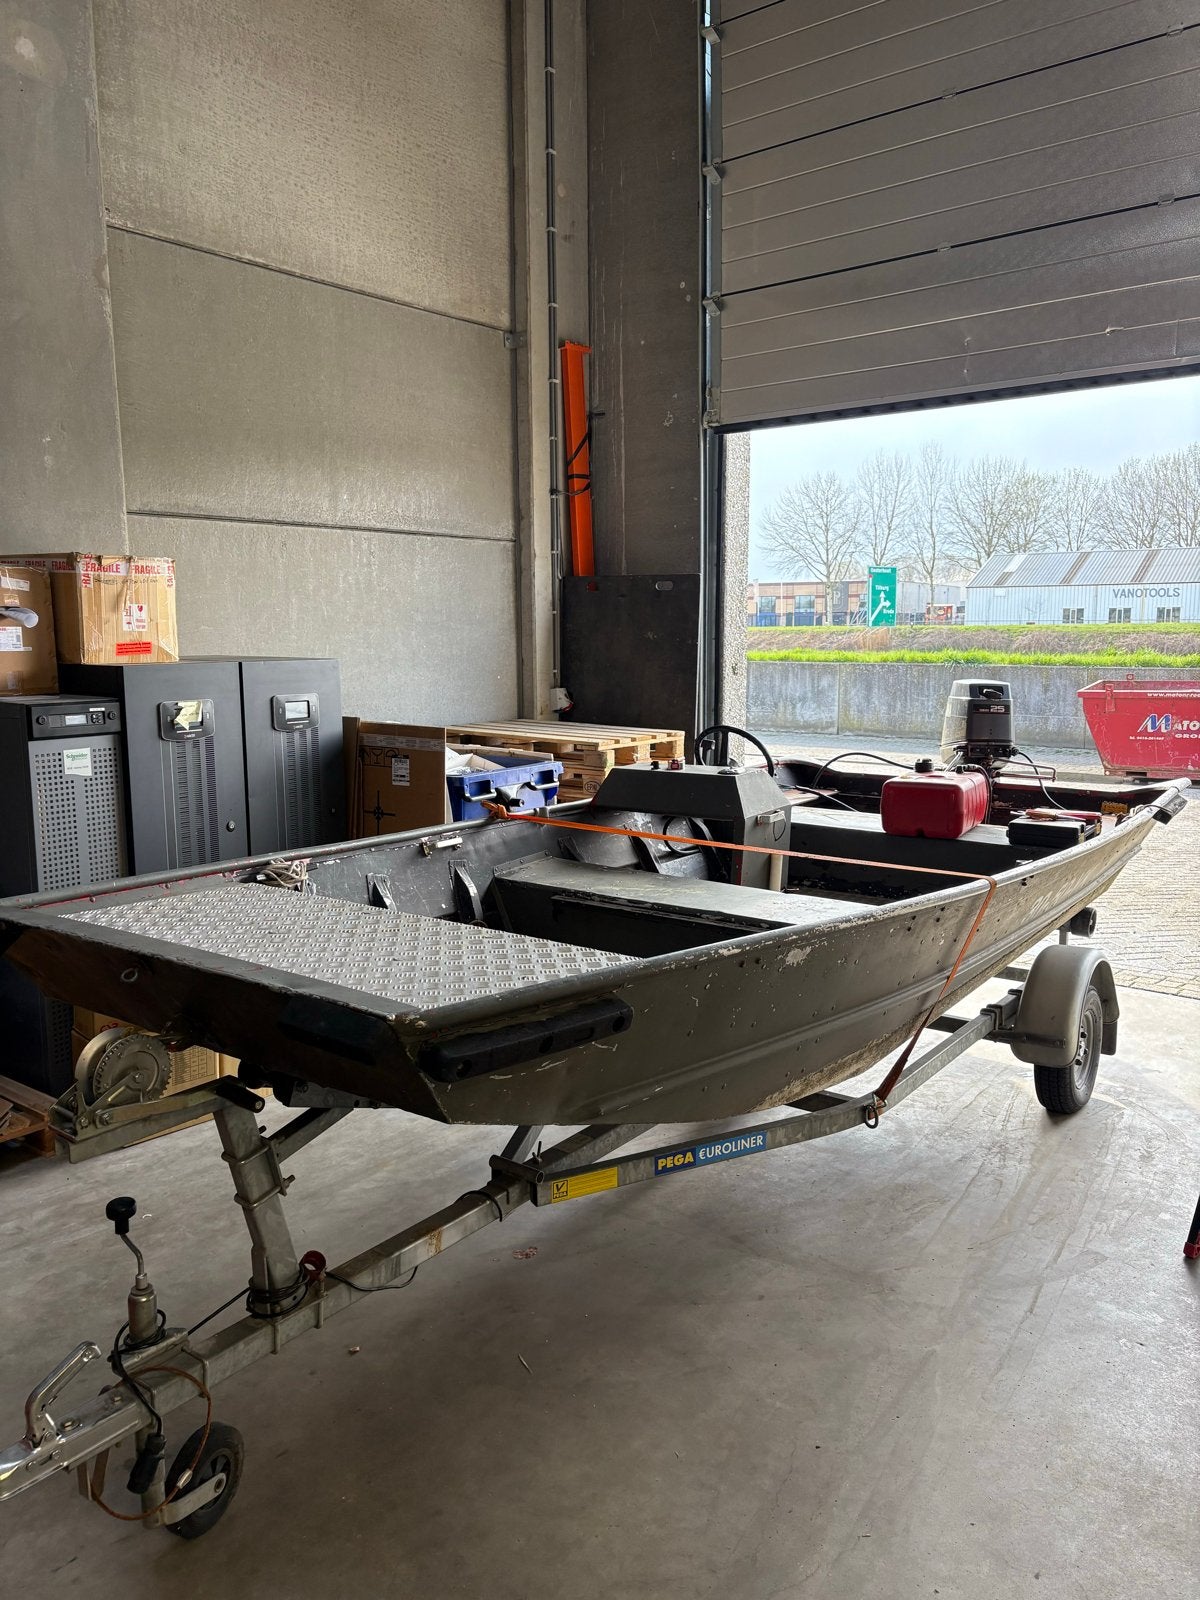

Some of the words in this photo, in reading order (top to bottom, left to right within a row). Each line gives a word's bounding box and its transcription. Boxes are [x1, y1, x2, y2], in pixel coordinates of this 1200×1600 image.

[86, 563, 120, 573] FRAGILE
[131, 564, 161, 575] FRAGILE
[1113, 588, 1180, 598] VANOTOOLS
[990, 705, 1005, 713] 25
[657, 1151, 695, 1171] PEGA
[698, 1135, 764, 1160] €UROLINER
